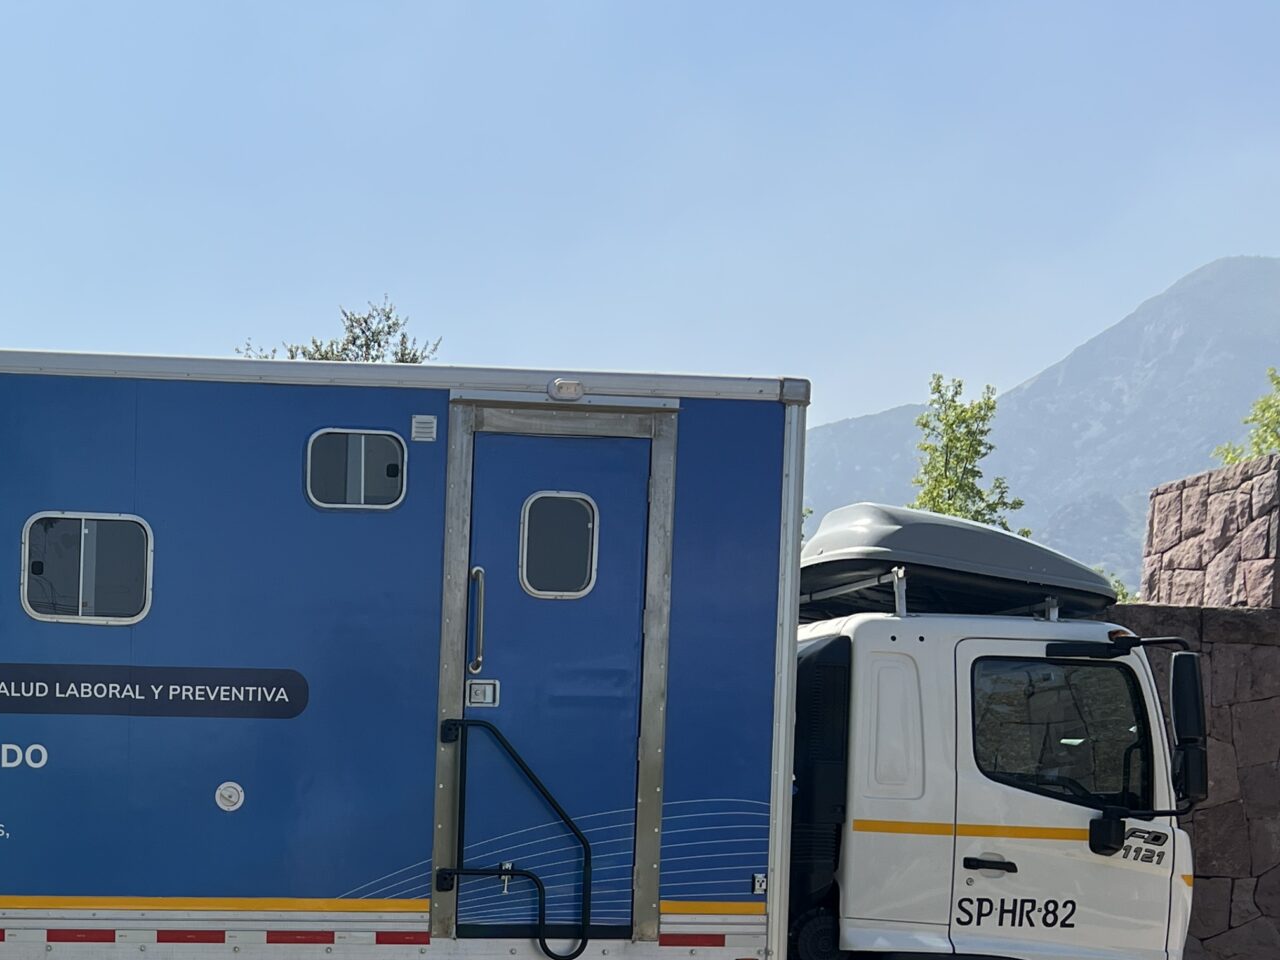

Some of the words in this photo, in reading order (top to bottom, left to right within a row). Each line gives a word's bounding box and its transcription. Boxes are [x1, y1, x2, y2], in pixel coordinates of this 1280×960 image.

[55, 682, 145, 699] LABORAL
[150, 684, 164, 700] Y
[169, 685, 289, 702] PREVENTIVA
[1126, 827, 1168, 846] FD
[1123, 845, 1166, 865] 1121
